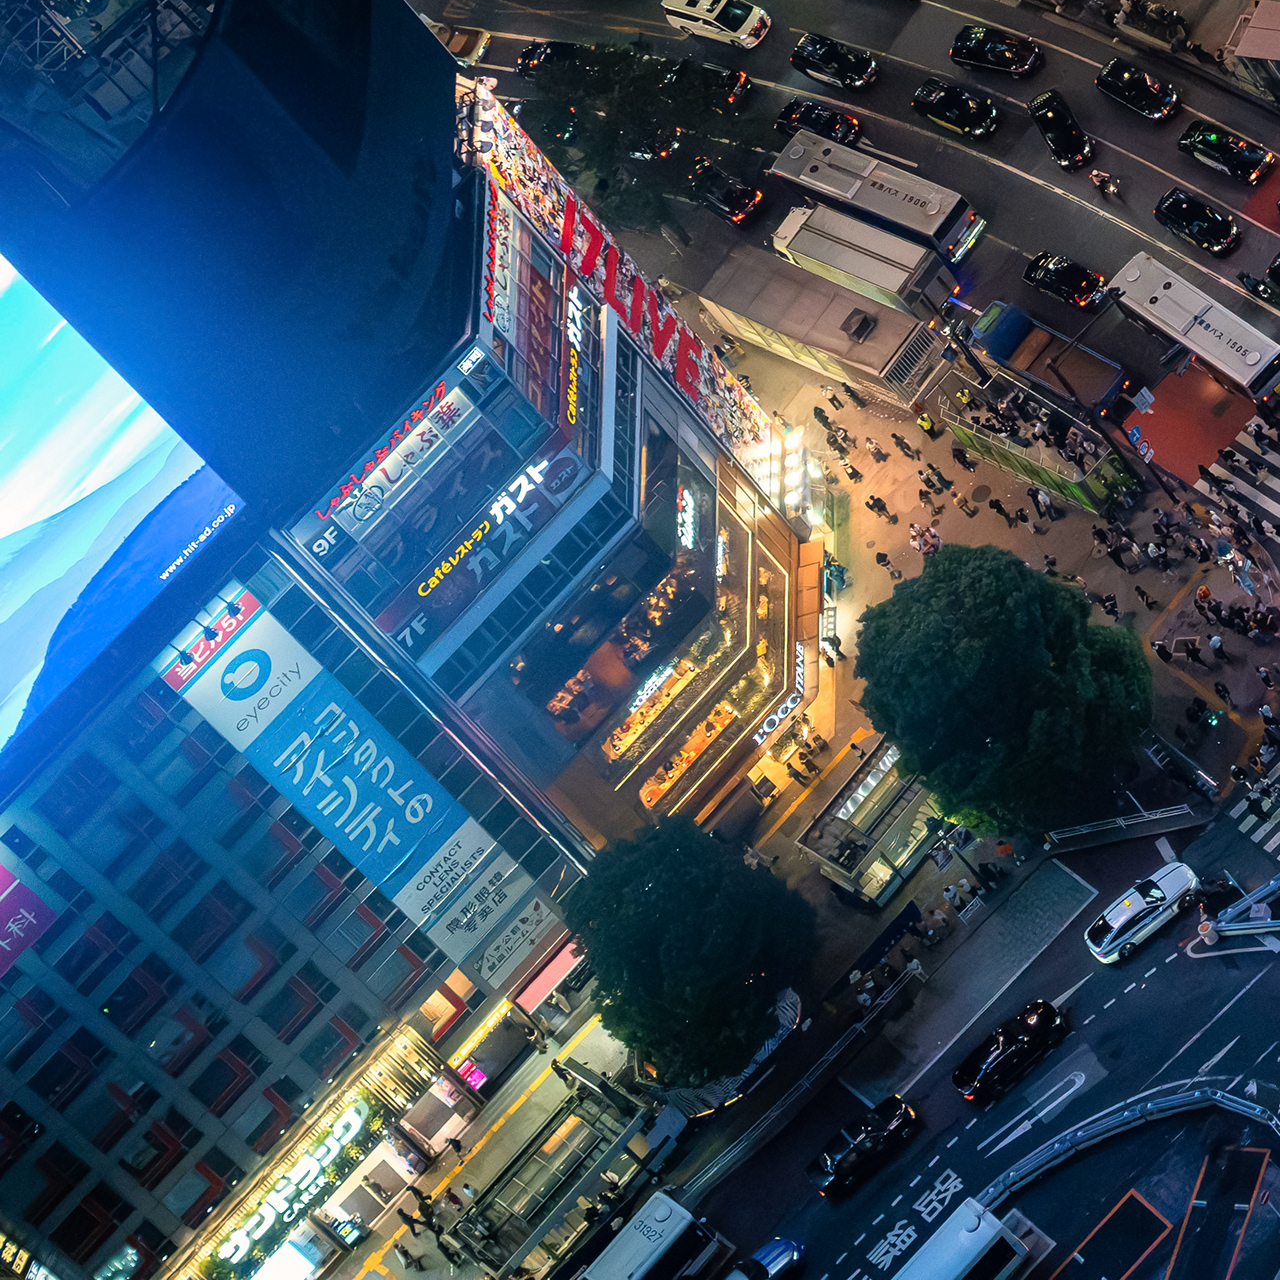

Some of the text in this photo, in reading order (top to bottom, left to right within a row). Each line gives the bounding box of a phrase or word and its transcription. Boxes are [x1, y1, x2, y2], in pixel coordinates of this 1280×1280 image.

[316, 381, 446, 520] しゃぶしゃぶバイキング
[379, 400, 462, 484] しゃぶ葉
[489, 459, 549, 523] ガスト
[159, 502, 237, 582] www.hit-ad.co.jp
[312, 526, 338, 557] 9F
[416, 518, 493, 598] Caféレストラン
[396, 613, 428, 648] 7F
[235, 661, 303, 732] eyecity
[273, 732, 401, 853] アイシティ
[313, 702, 433, 824] コンタクトの
[415, 840, 463, 892] CONTACT
[421, 846, 485, 915] SPECIALISTS
[431, 859, 462, 887] LENS
[217, 1105, 365, 1263] サンドラッグ
[866, 1168, 964, 1271] 路線
[633, 1220, 663, 1243] 31327
